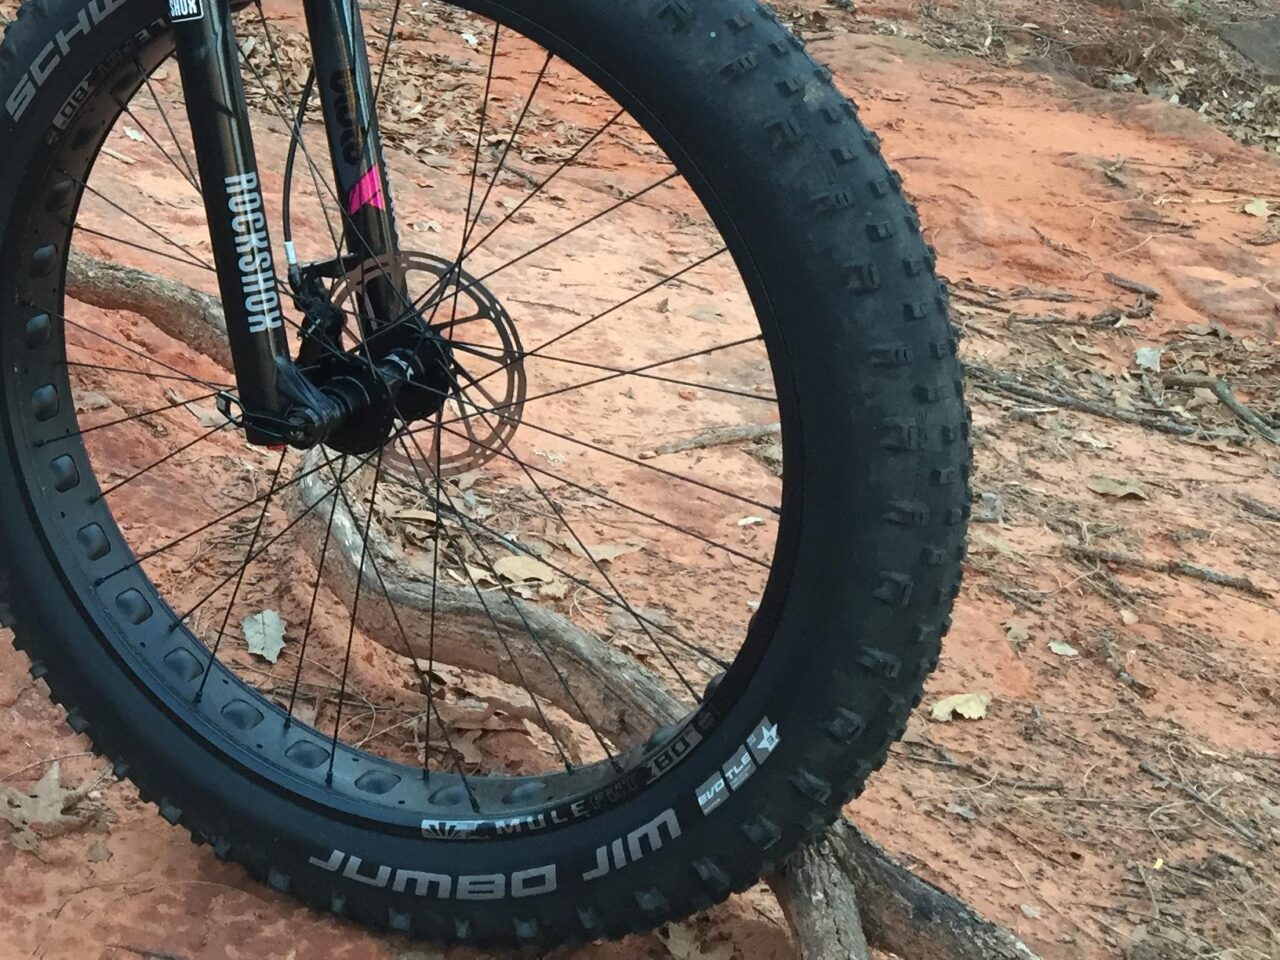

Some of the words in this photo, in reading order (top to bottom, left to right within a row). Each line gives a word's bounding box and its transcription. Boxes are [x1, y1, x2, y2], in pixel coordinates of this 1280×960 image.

[224, 171, 282, 334] ROCKSHOX
[697, 778, 725, 806] EVO
[725, 751, 751, 780] TLE
[308, 848, 557, 901] JUMBO
[582, 806, 682, 882] JIM
